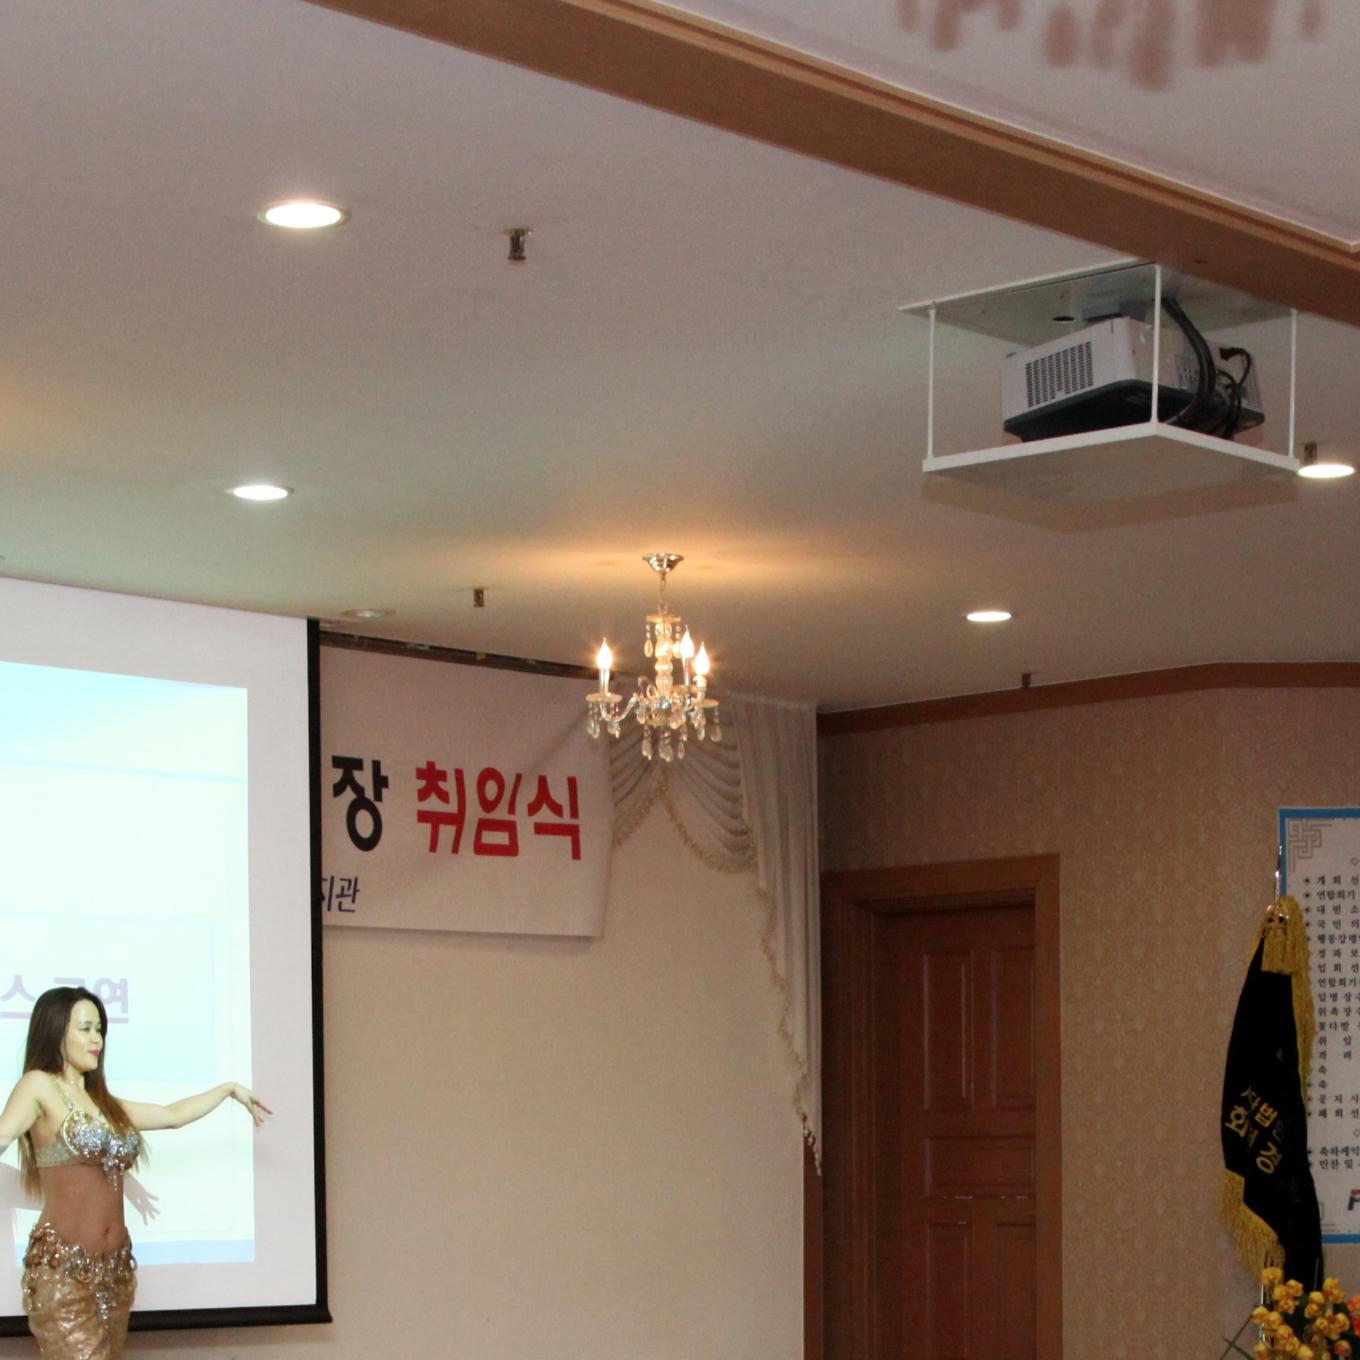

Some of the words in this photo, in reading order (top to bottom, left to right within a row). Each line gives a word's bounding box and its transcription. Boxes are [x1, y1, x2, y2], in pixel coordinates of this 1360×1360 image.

[332, 755, 389, 852] 장
[416, 760, 582, 861] 취임식
[1319, 1158, 1339, 1170] 만찬
[1344, 1158, 1354, 1169] 및
